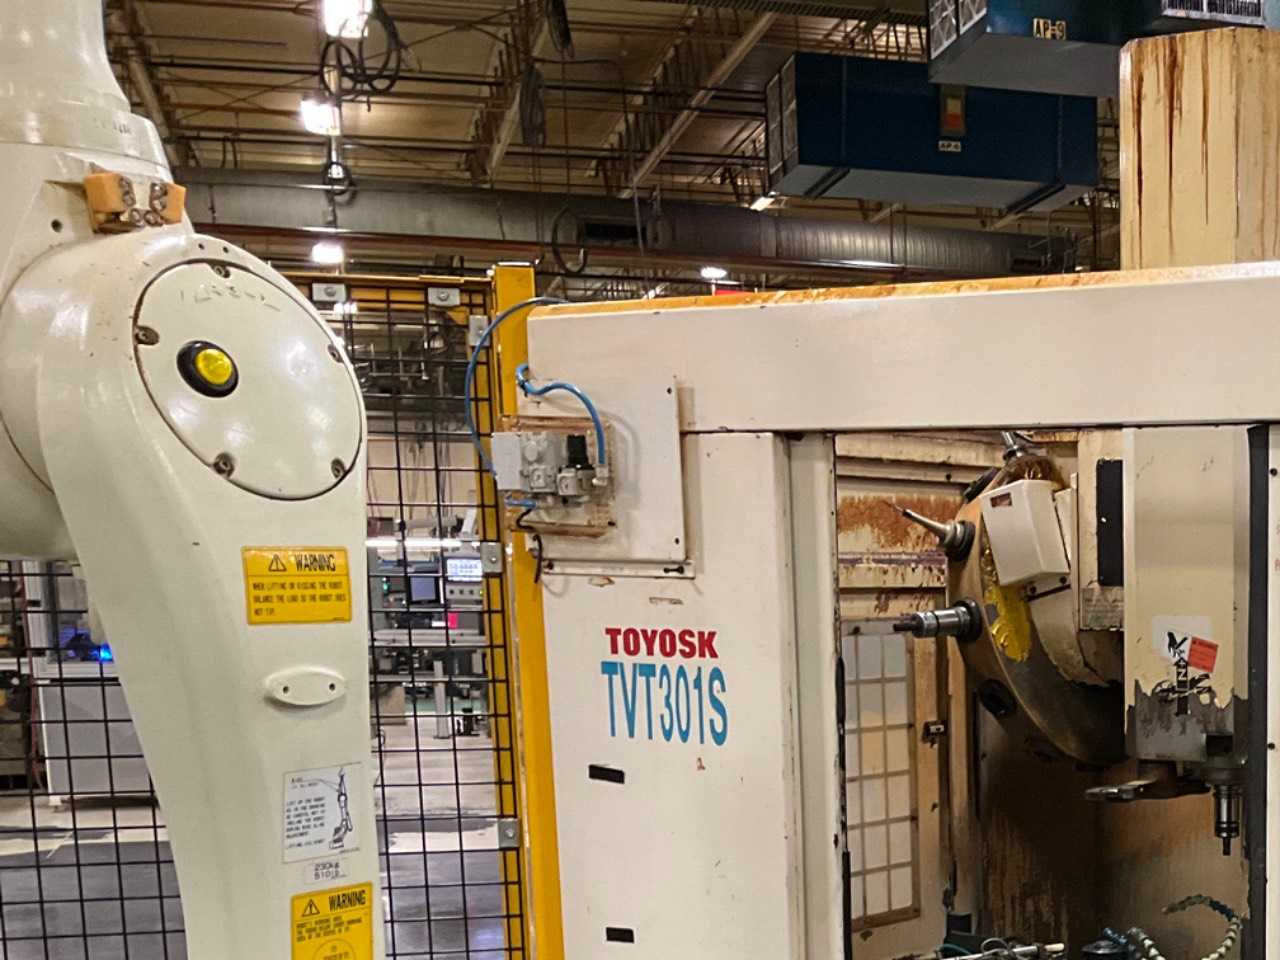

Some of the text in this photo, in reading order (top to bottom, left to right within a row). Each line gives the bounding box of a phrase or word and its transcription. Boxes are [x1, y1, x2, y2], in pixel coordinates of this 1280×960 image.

[294, 553, 337, 573] WARNING
[605, 627, 719, 659] TOYOSK
[600, 661, 728, 747] TVT301S
[328, 889, 366, 912] WARNING
